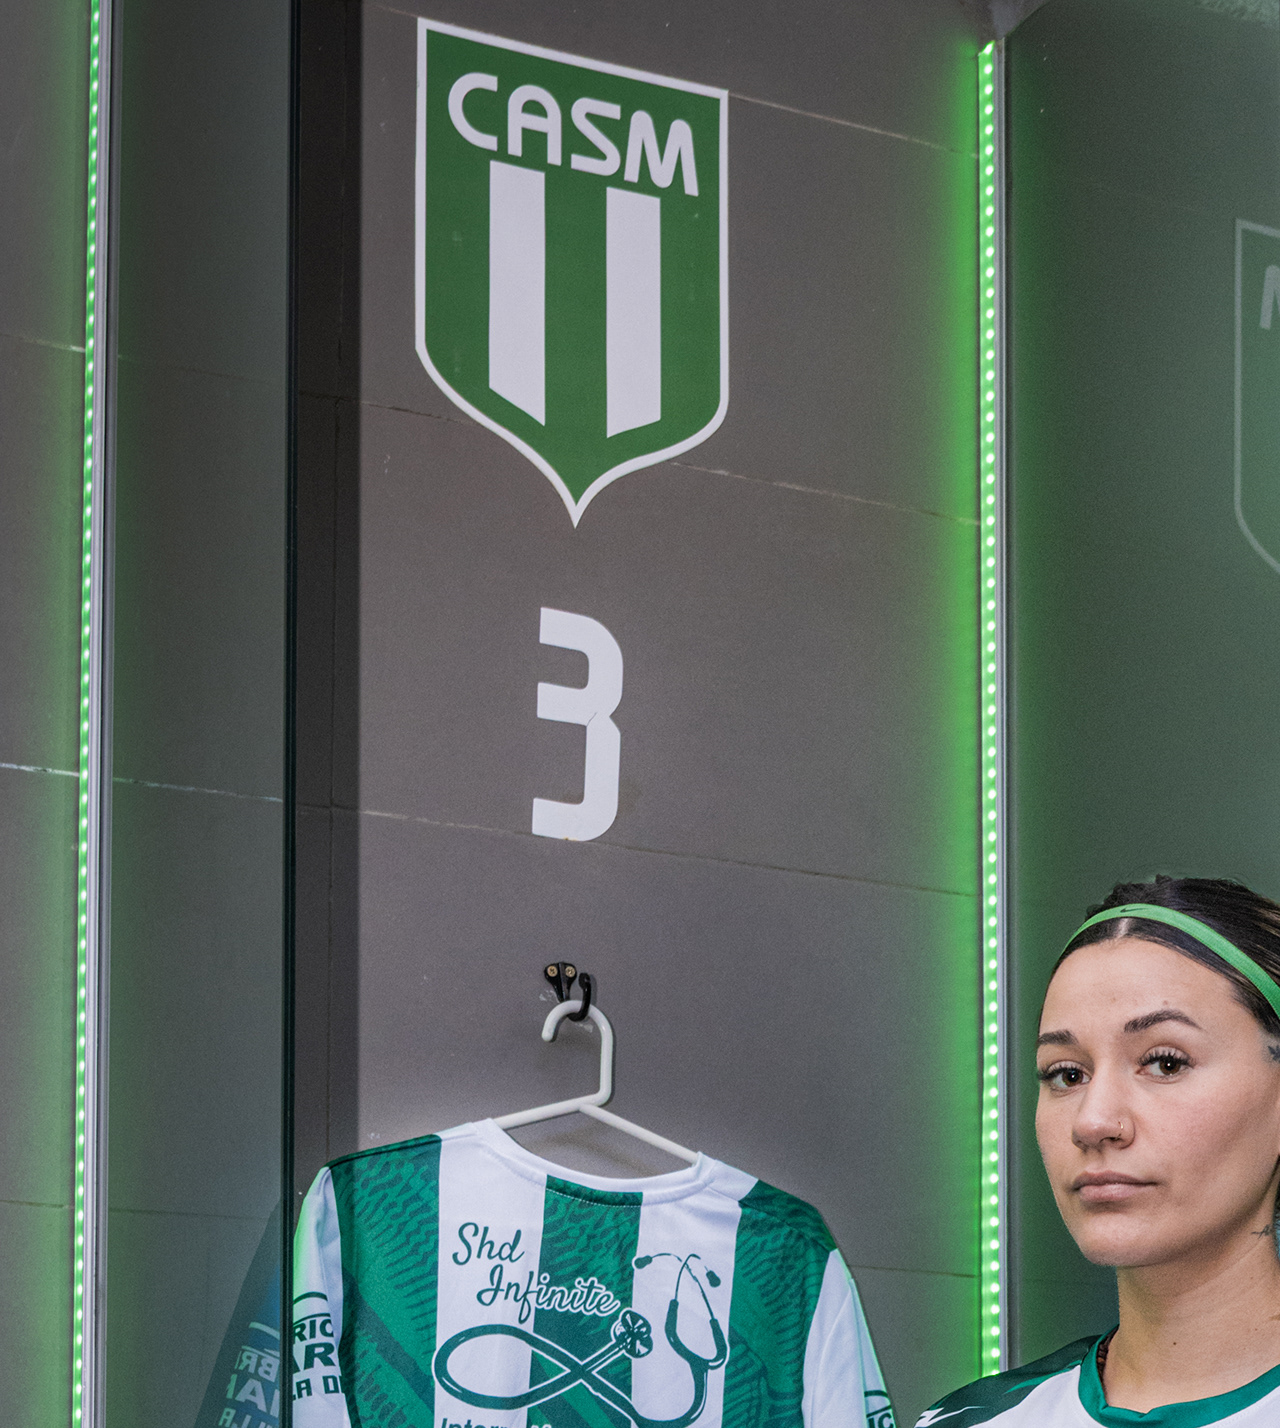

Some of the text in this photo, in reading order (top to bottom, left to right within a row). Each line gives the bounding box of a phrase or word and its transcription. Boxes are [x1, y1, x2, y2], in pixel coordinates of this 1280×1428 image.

[447, 72, 698, 197] CASM
[532, 606, 623, 842] 3
[452, 1222, 525, 1266] Shd
[476, 1264, 621, 1324] Infinite
